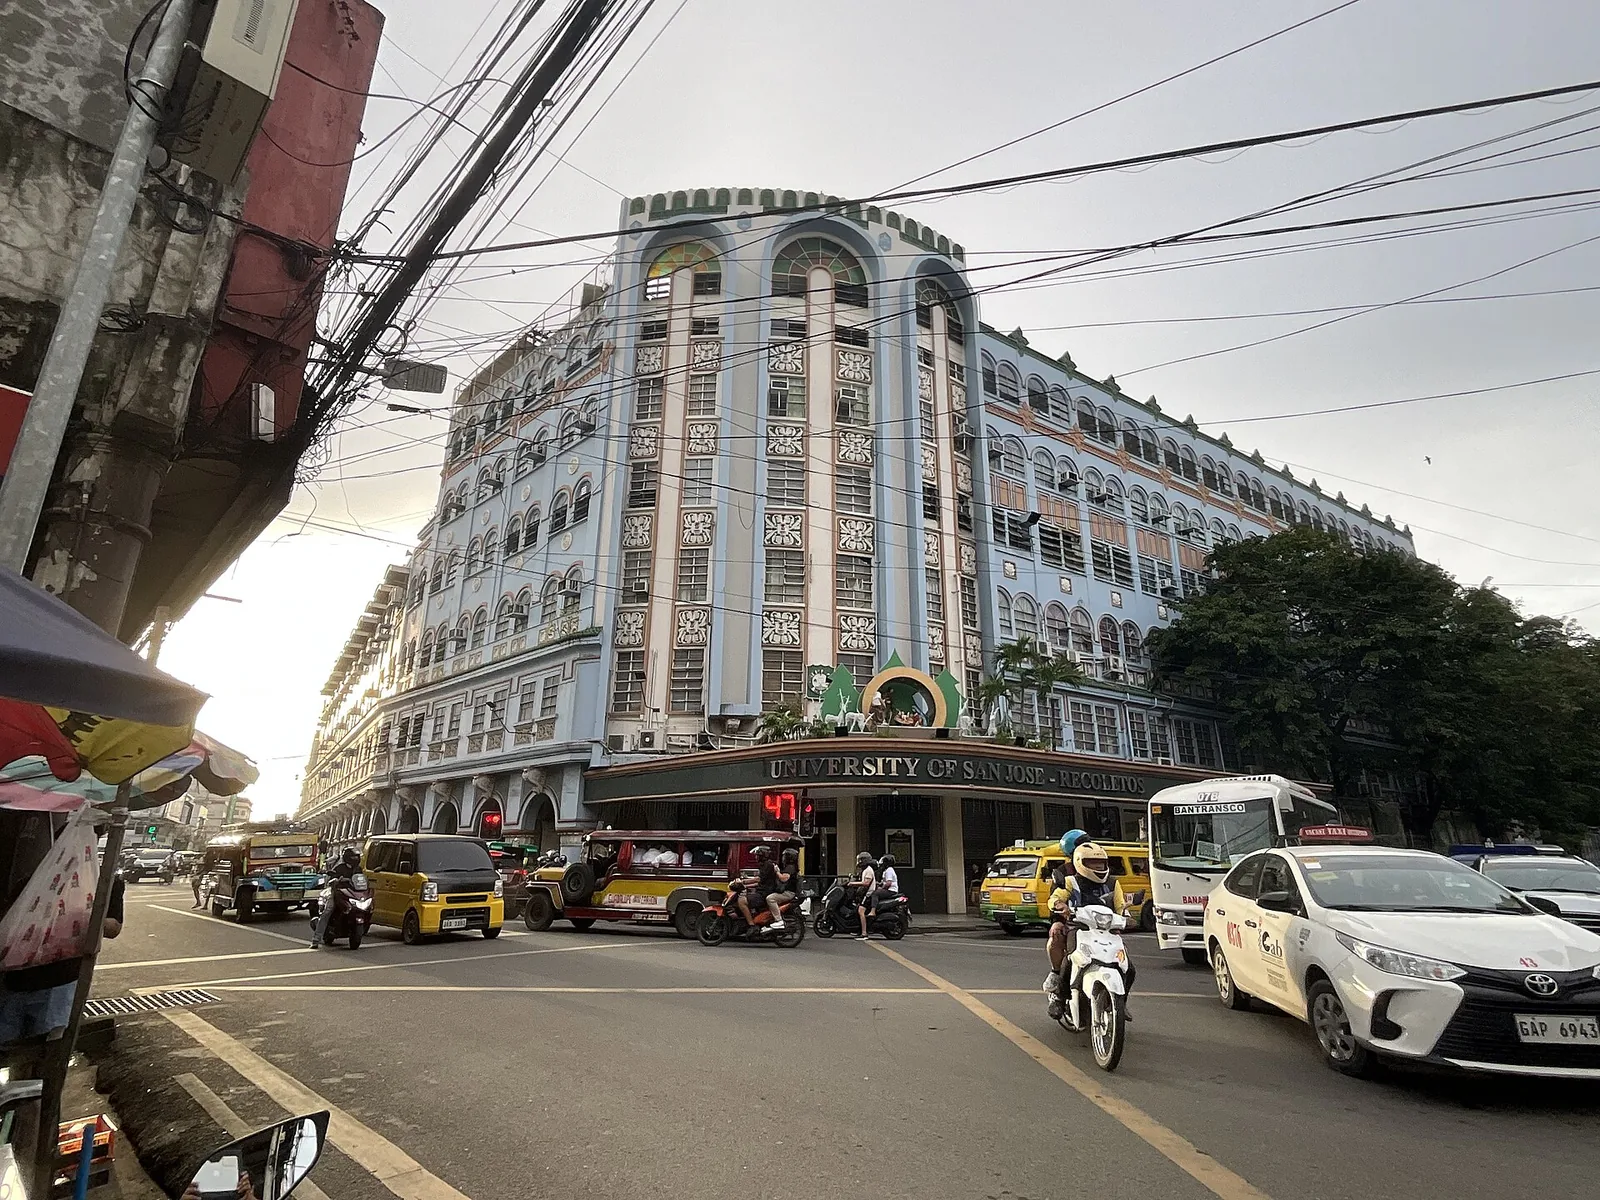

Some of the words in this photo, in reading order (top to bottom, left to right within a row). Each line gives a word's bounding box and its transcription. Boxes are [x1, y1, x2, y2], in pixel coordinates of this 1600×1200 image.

[770, 756, 920, 779] UNIVERSITY
[927, 758, 957, 778] OF
[963, 760, 1000, 781] SAN
[1005, 764, 1045, 785] JOSE
[1059, 770, 1146, 793] RECOLETOS
[764, 793, 796, 820] 47
[1174, 804, 1244, 814] BANTRANSCO
[1520, 957, 1538, 968] 43
[1519, 1021, 1547, 1037] GAP
[1560, 1022, 1598, 1038] 6943
